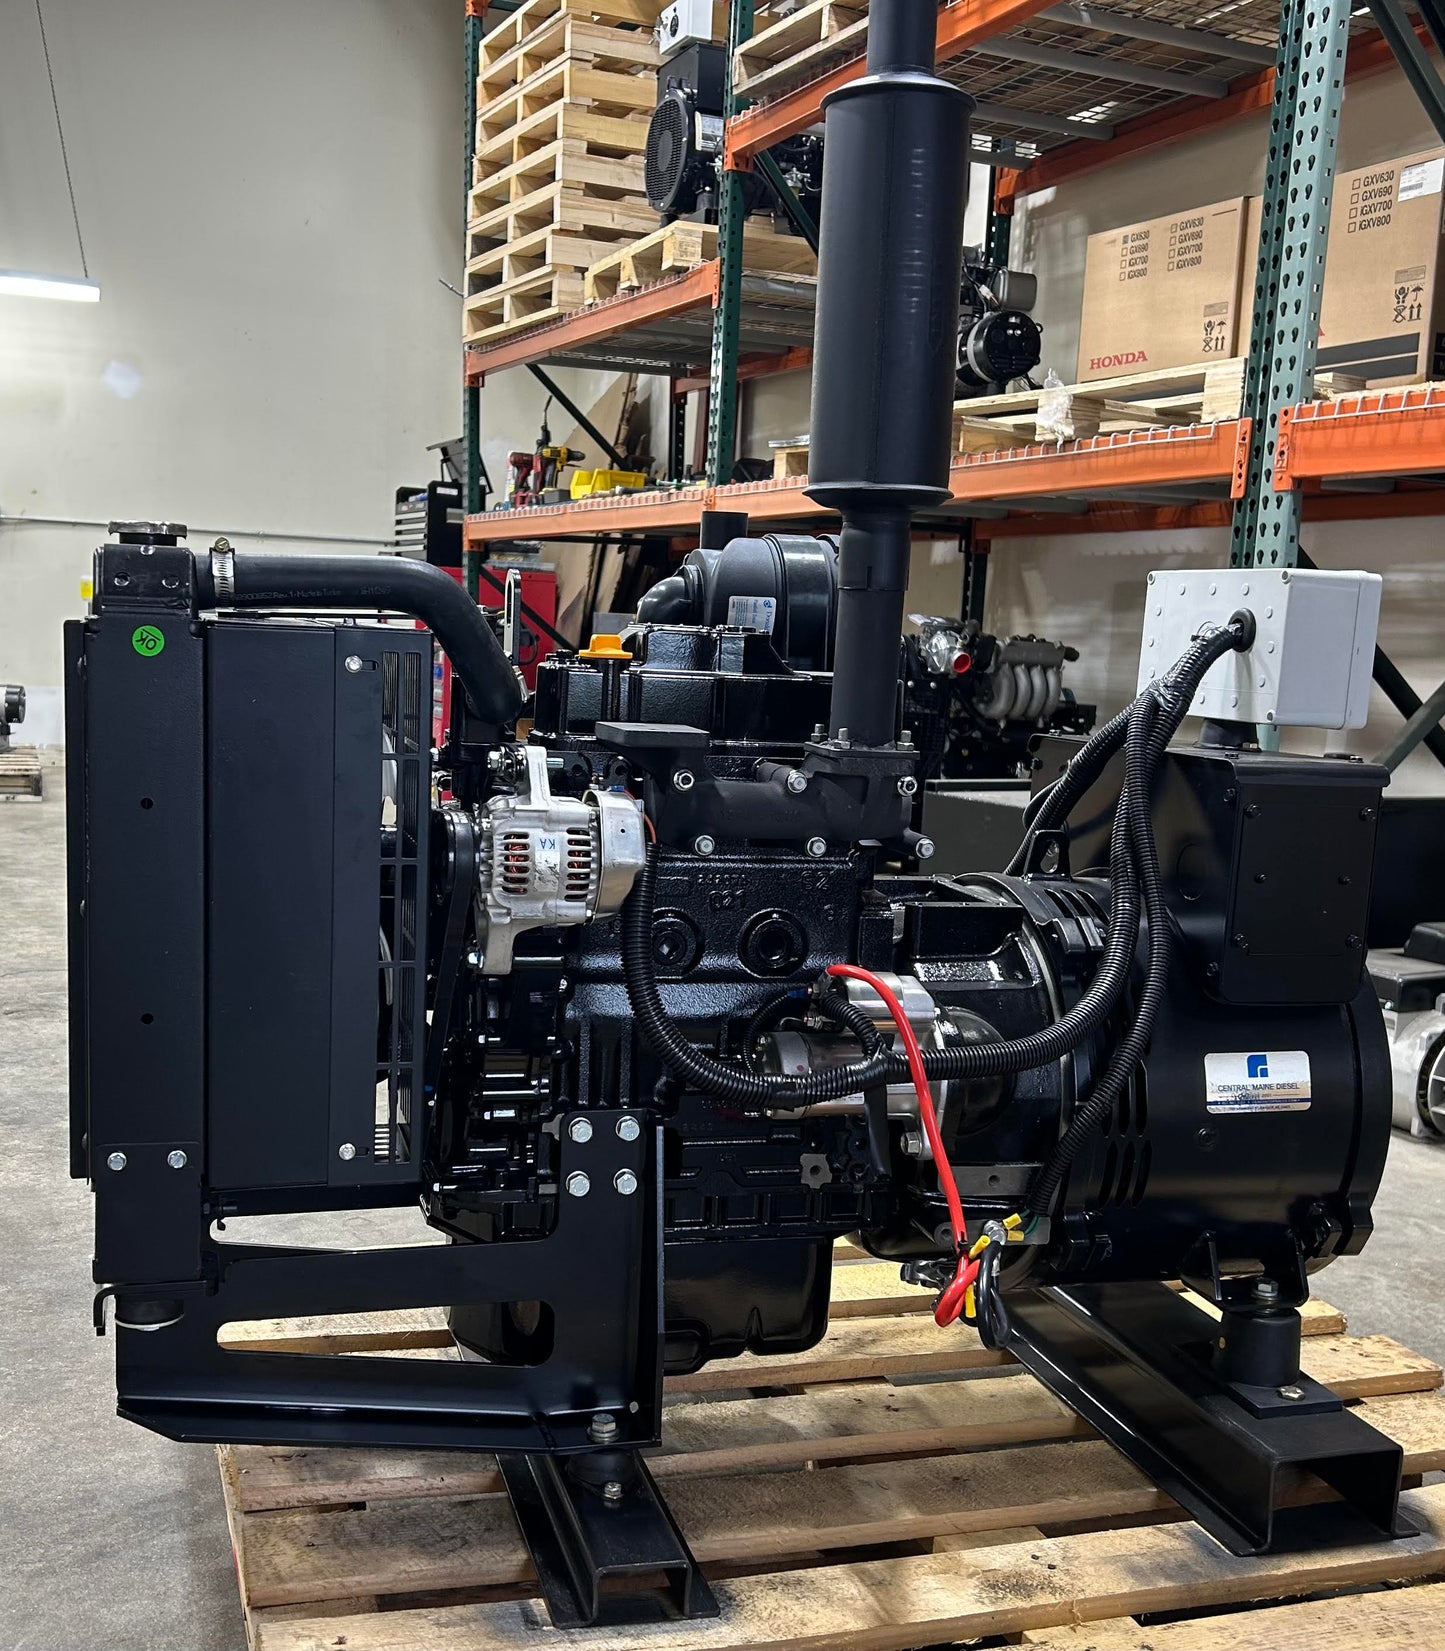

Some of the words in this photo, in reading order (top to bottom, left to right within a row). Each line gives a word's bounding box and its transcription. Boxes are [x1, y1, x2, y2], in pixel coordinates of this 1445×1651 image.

[1363, 170, 1394, 187] GXV630
[1361, 185, 1392, 202] GXV690
[1360, 200, 1392, 216] iGXV700
[1179, 217, 1204, 231] GXV630
[1358, 214, 1391, 231] iGXV800
[1130, 230, 1150, 242] GX630
[1178, 230, 1203, 244] GXV690
[1177, 243, 1203, 257] iGXV700
[1176, 256, 1202, 270] iGXV800
[1089, 351, 1148, 369] HONDA
[136, 631, 157, 650] OK
[540, 838, 555, 849] KA
[1218, 1084, 1250, 1092] CENTRAL
[1252, 1083, 1273, 1091] MAINE
